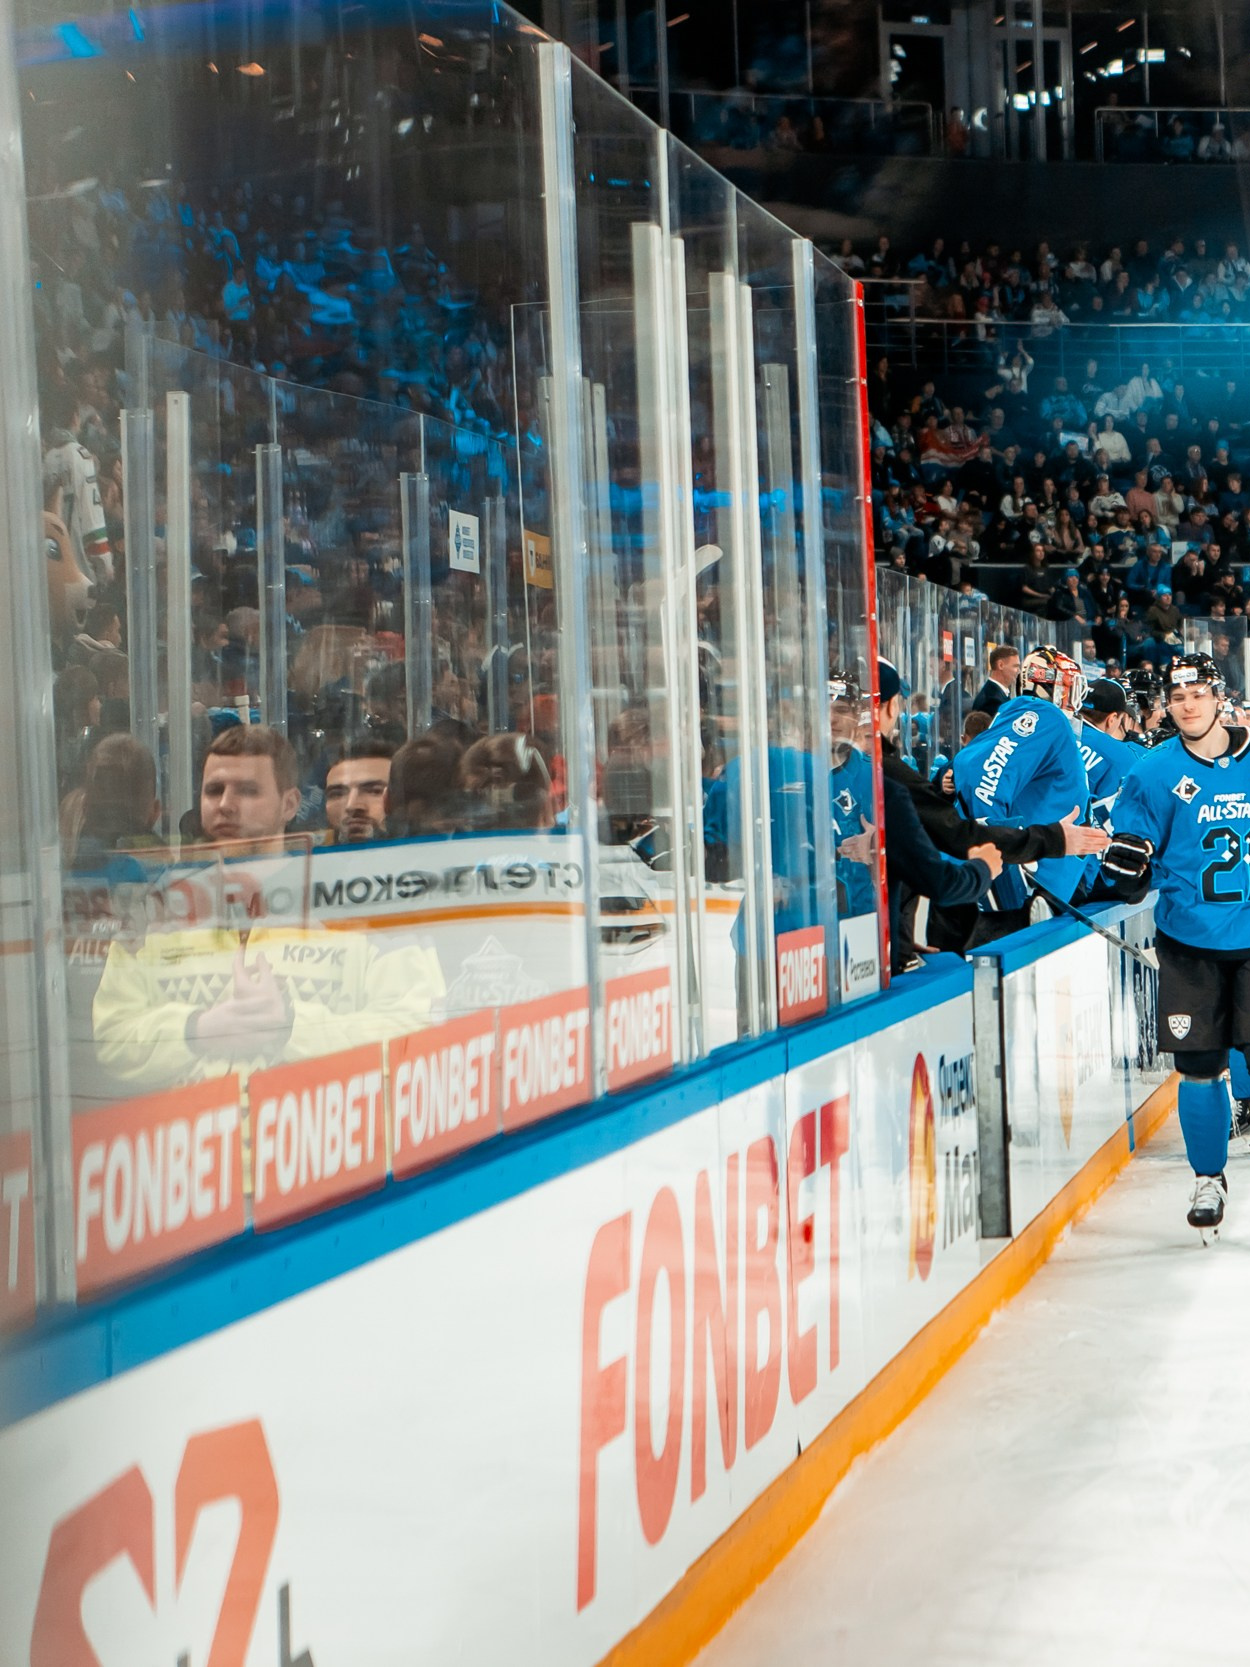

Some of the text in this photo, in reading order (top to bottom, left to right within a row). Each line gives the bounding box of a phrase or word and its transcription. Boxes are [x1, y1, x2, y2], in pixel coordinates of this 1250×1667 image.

[1213, 793, 1246, 802] FONBET
[608, 986, 672, 1074] FONBET
[780, 943, 825, 1010] FONBET
[394, 1031, 495, 1155] FONBET
[503, 1007, 590, 1112] FONBET
[77, 1103, 239, 1266] FONBET
[255, 1069, 382, 1204] FONBET
[576, 1092, 850, 1616] FONBET
